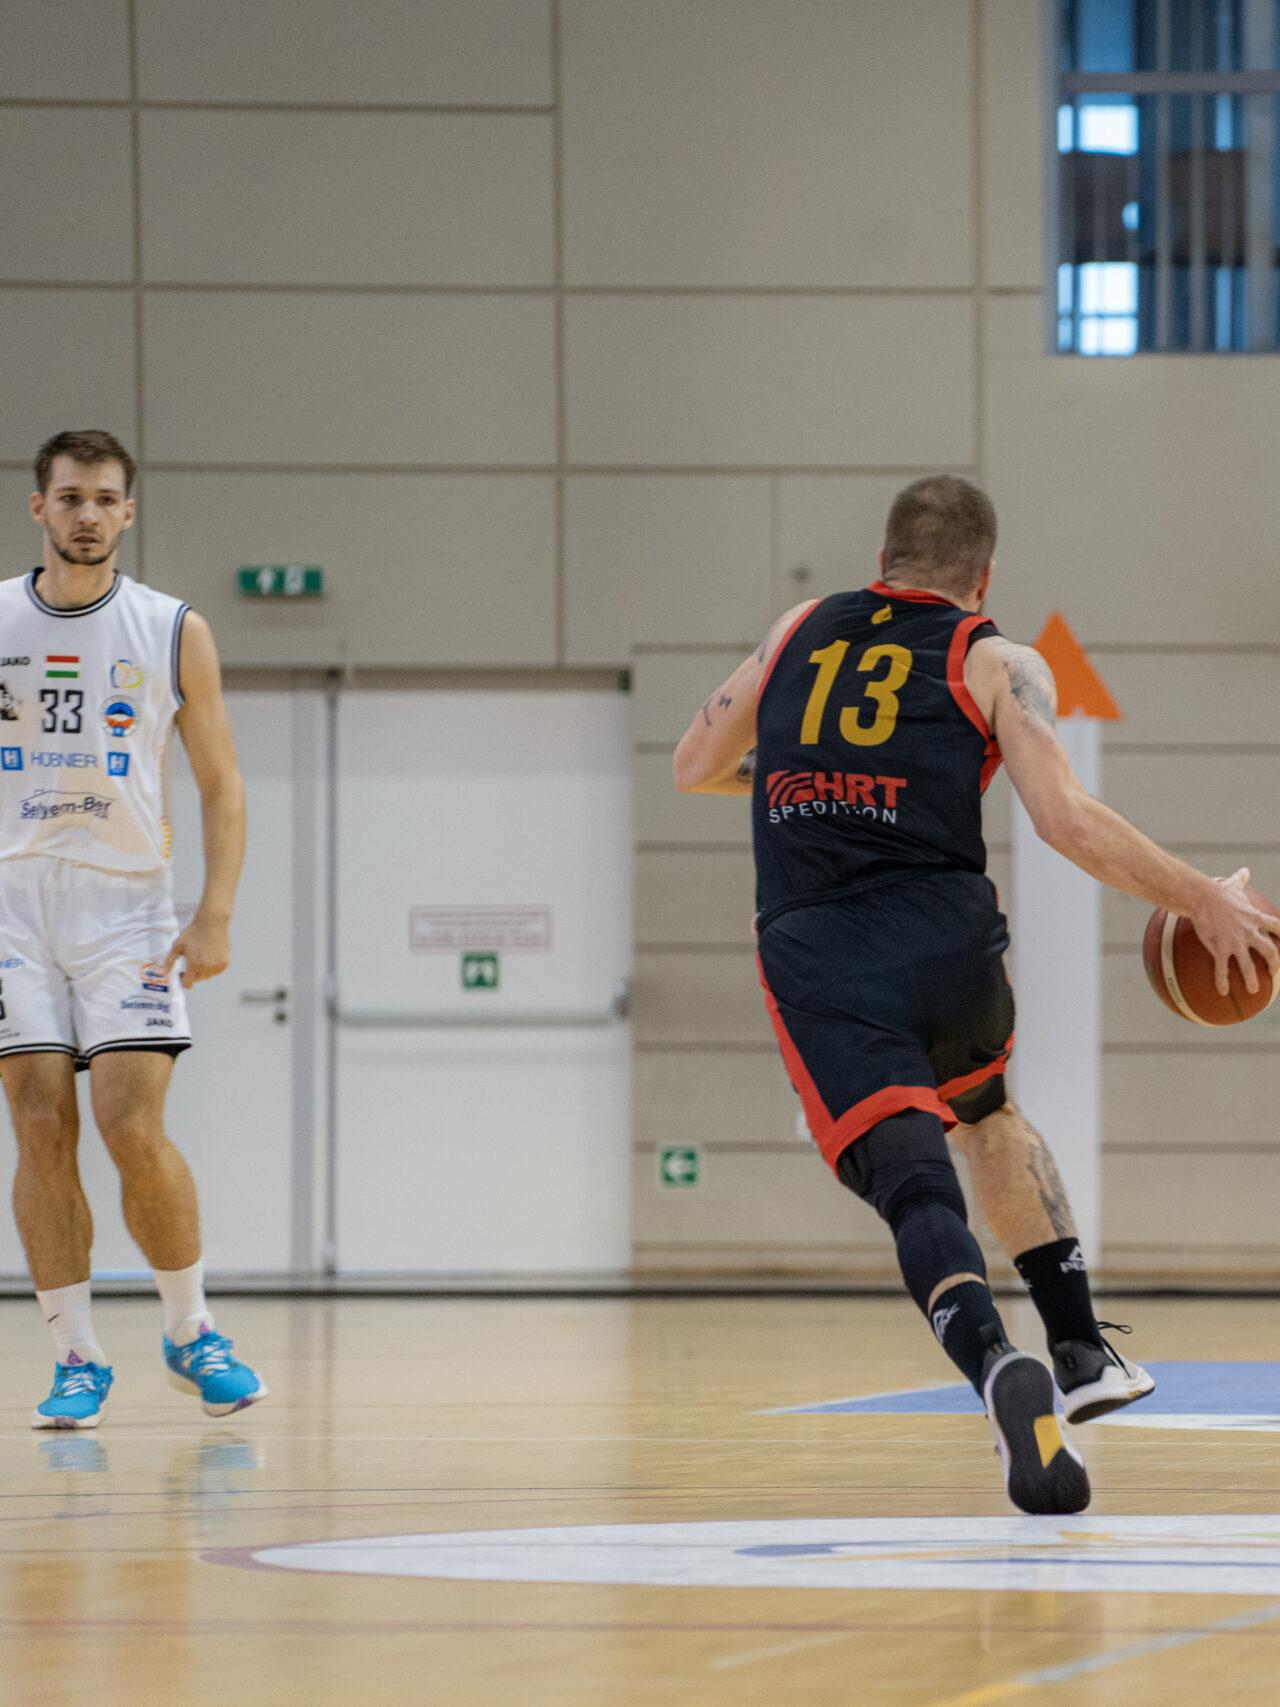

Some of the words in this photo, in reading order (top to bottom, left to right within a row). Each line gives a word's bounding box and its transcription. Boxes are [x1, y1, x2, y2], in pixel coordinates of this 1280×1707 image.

[39, 689, 83, 733] 33
[800, 640, 913, 747] 13
[815, 772, 907, 808] HRT
